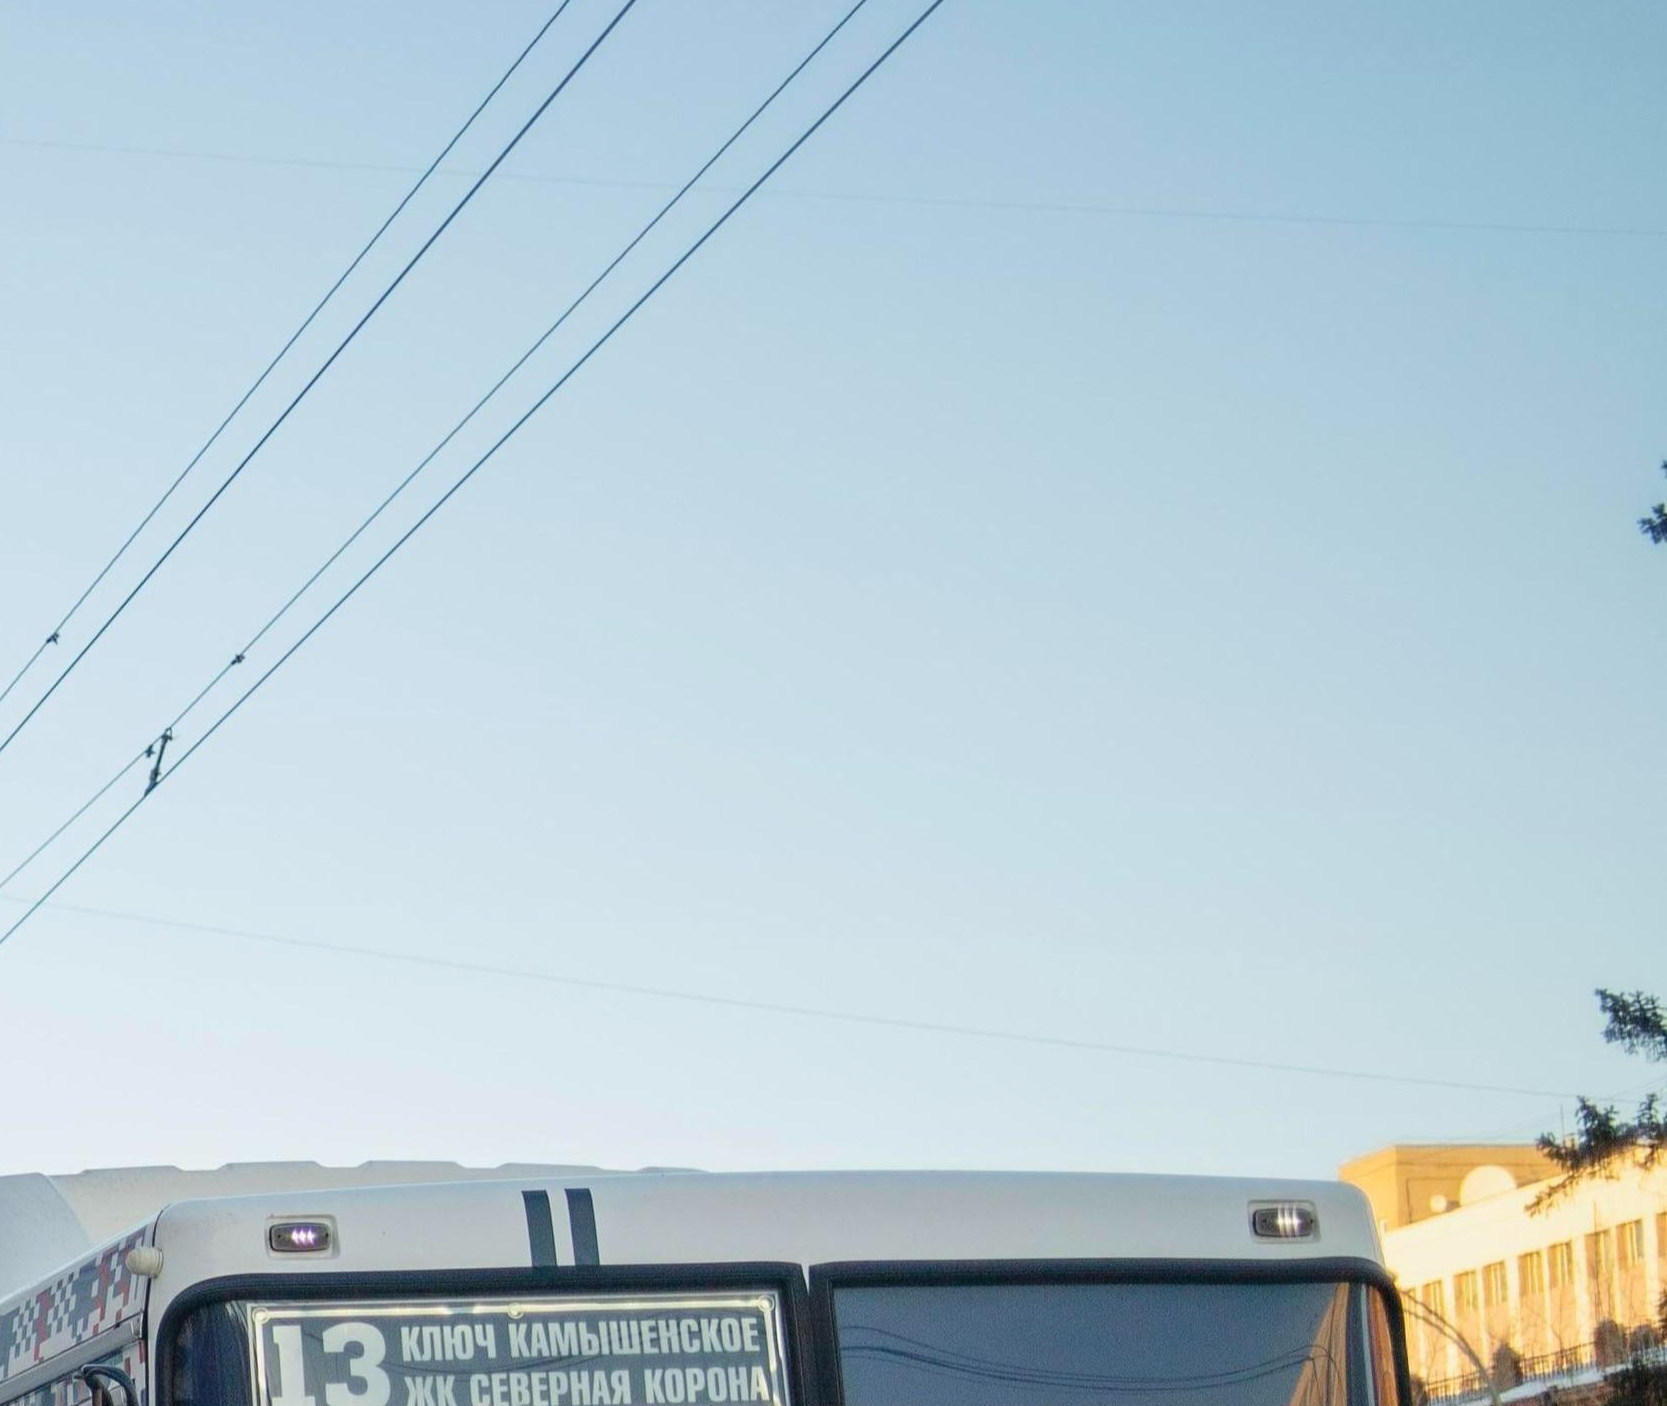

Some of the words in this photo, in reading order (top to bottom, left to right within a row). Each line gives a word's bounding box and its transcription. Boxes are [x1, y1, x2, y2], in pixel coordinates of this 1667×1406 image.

[401, 1325, 498, 1361] КЛЮЧ
[509, 1316, 761, 1358] КАМЫШЕНСКОЕ
[644, 1366, 770, 1404] КОРОНА
